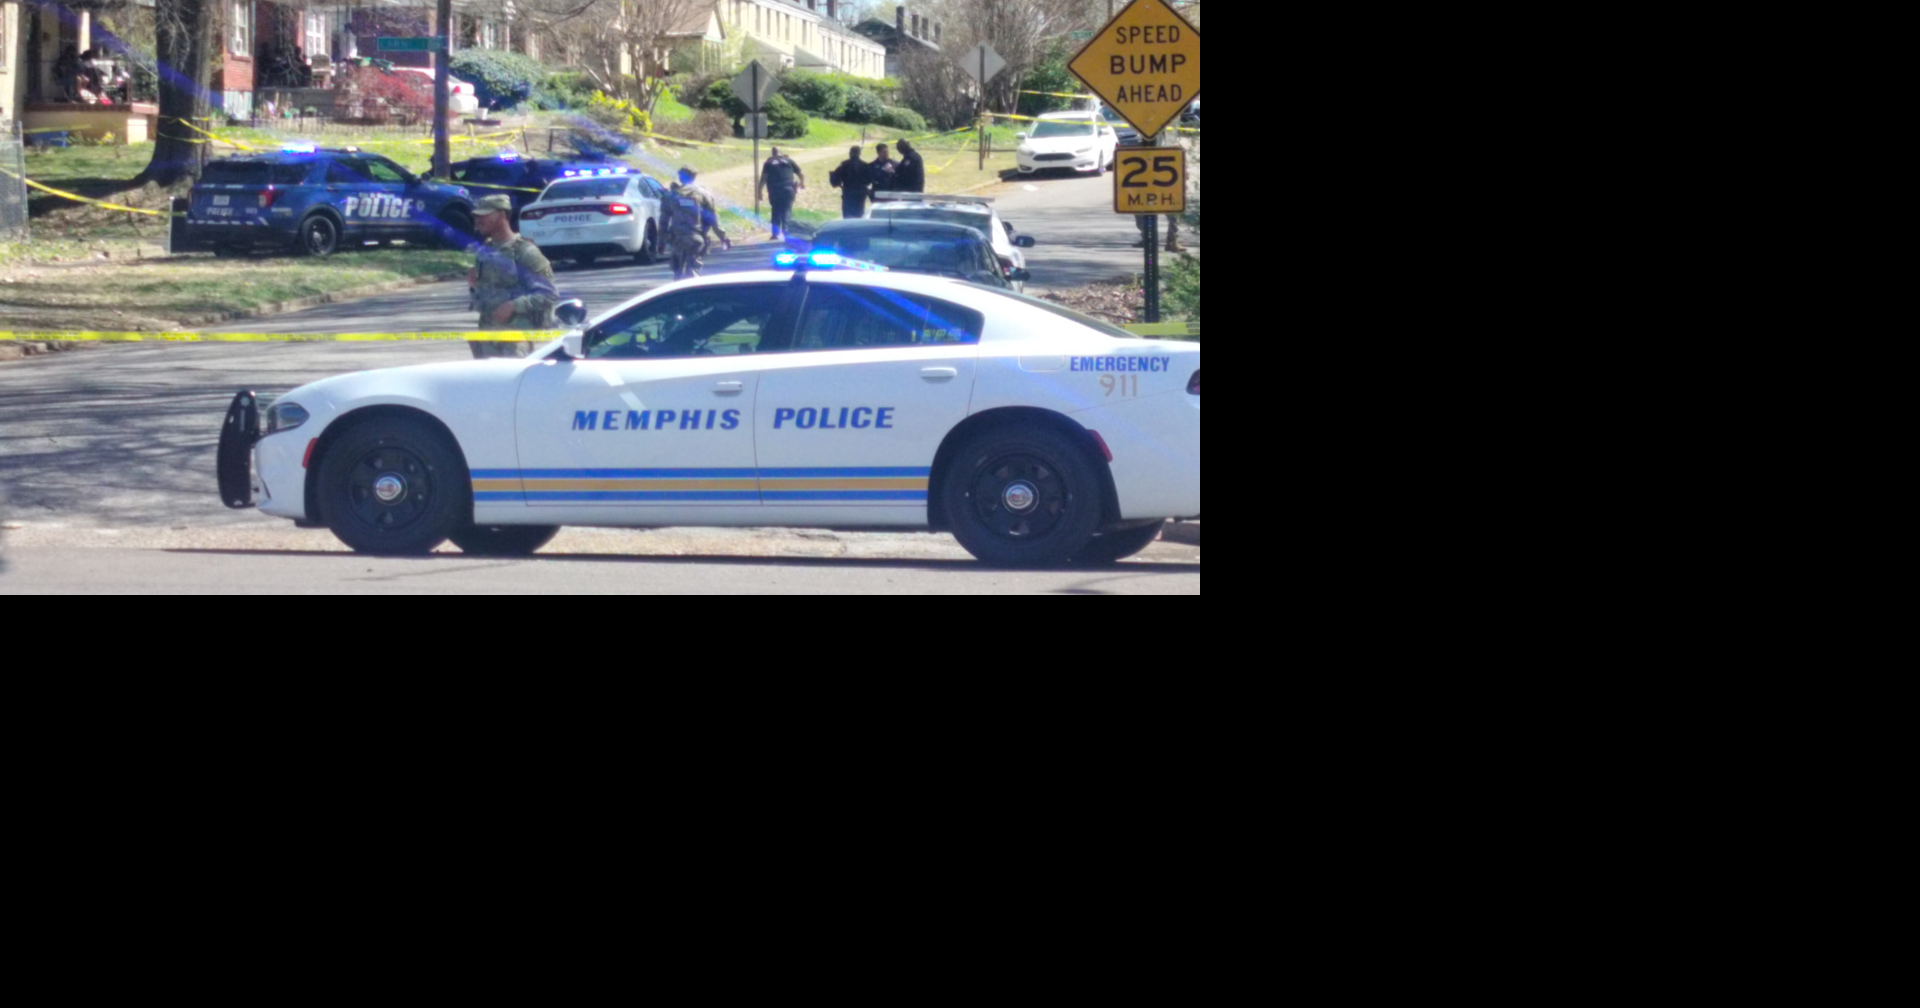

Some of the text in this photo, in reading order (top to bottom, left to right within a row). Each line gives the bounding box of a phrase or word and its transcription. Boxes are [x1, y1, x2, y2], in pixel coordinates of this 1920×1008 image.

[1116, 25, 1180, 44] SPEED
[1110, 54, 1186, 75] BUMP
[1116, 84, 1182, 103] AHEAD
[1121, 156, 1179, 188] 25
[345, 196, 414, 218] POLICE
[553, 213, 592, 223] POLICE
[1070, 356, 1170, 372] EMERGENCY
[1099, 373, 1138, 397] 911
[572, 407, 895, 430] MEMPHIS POLICE
